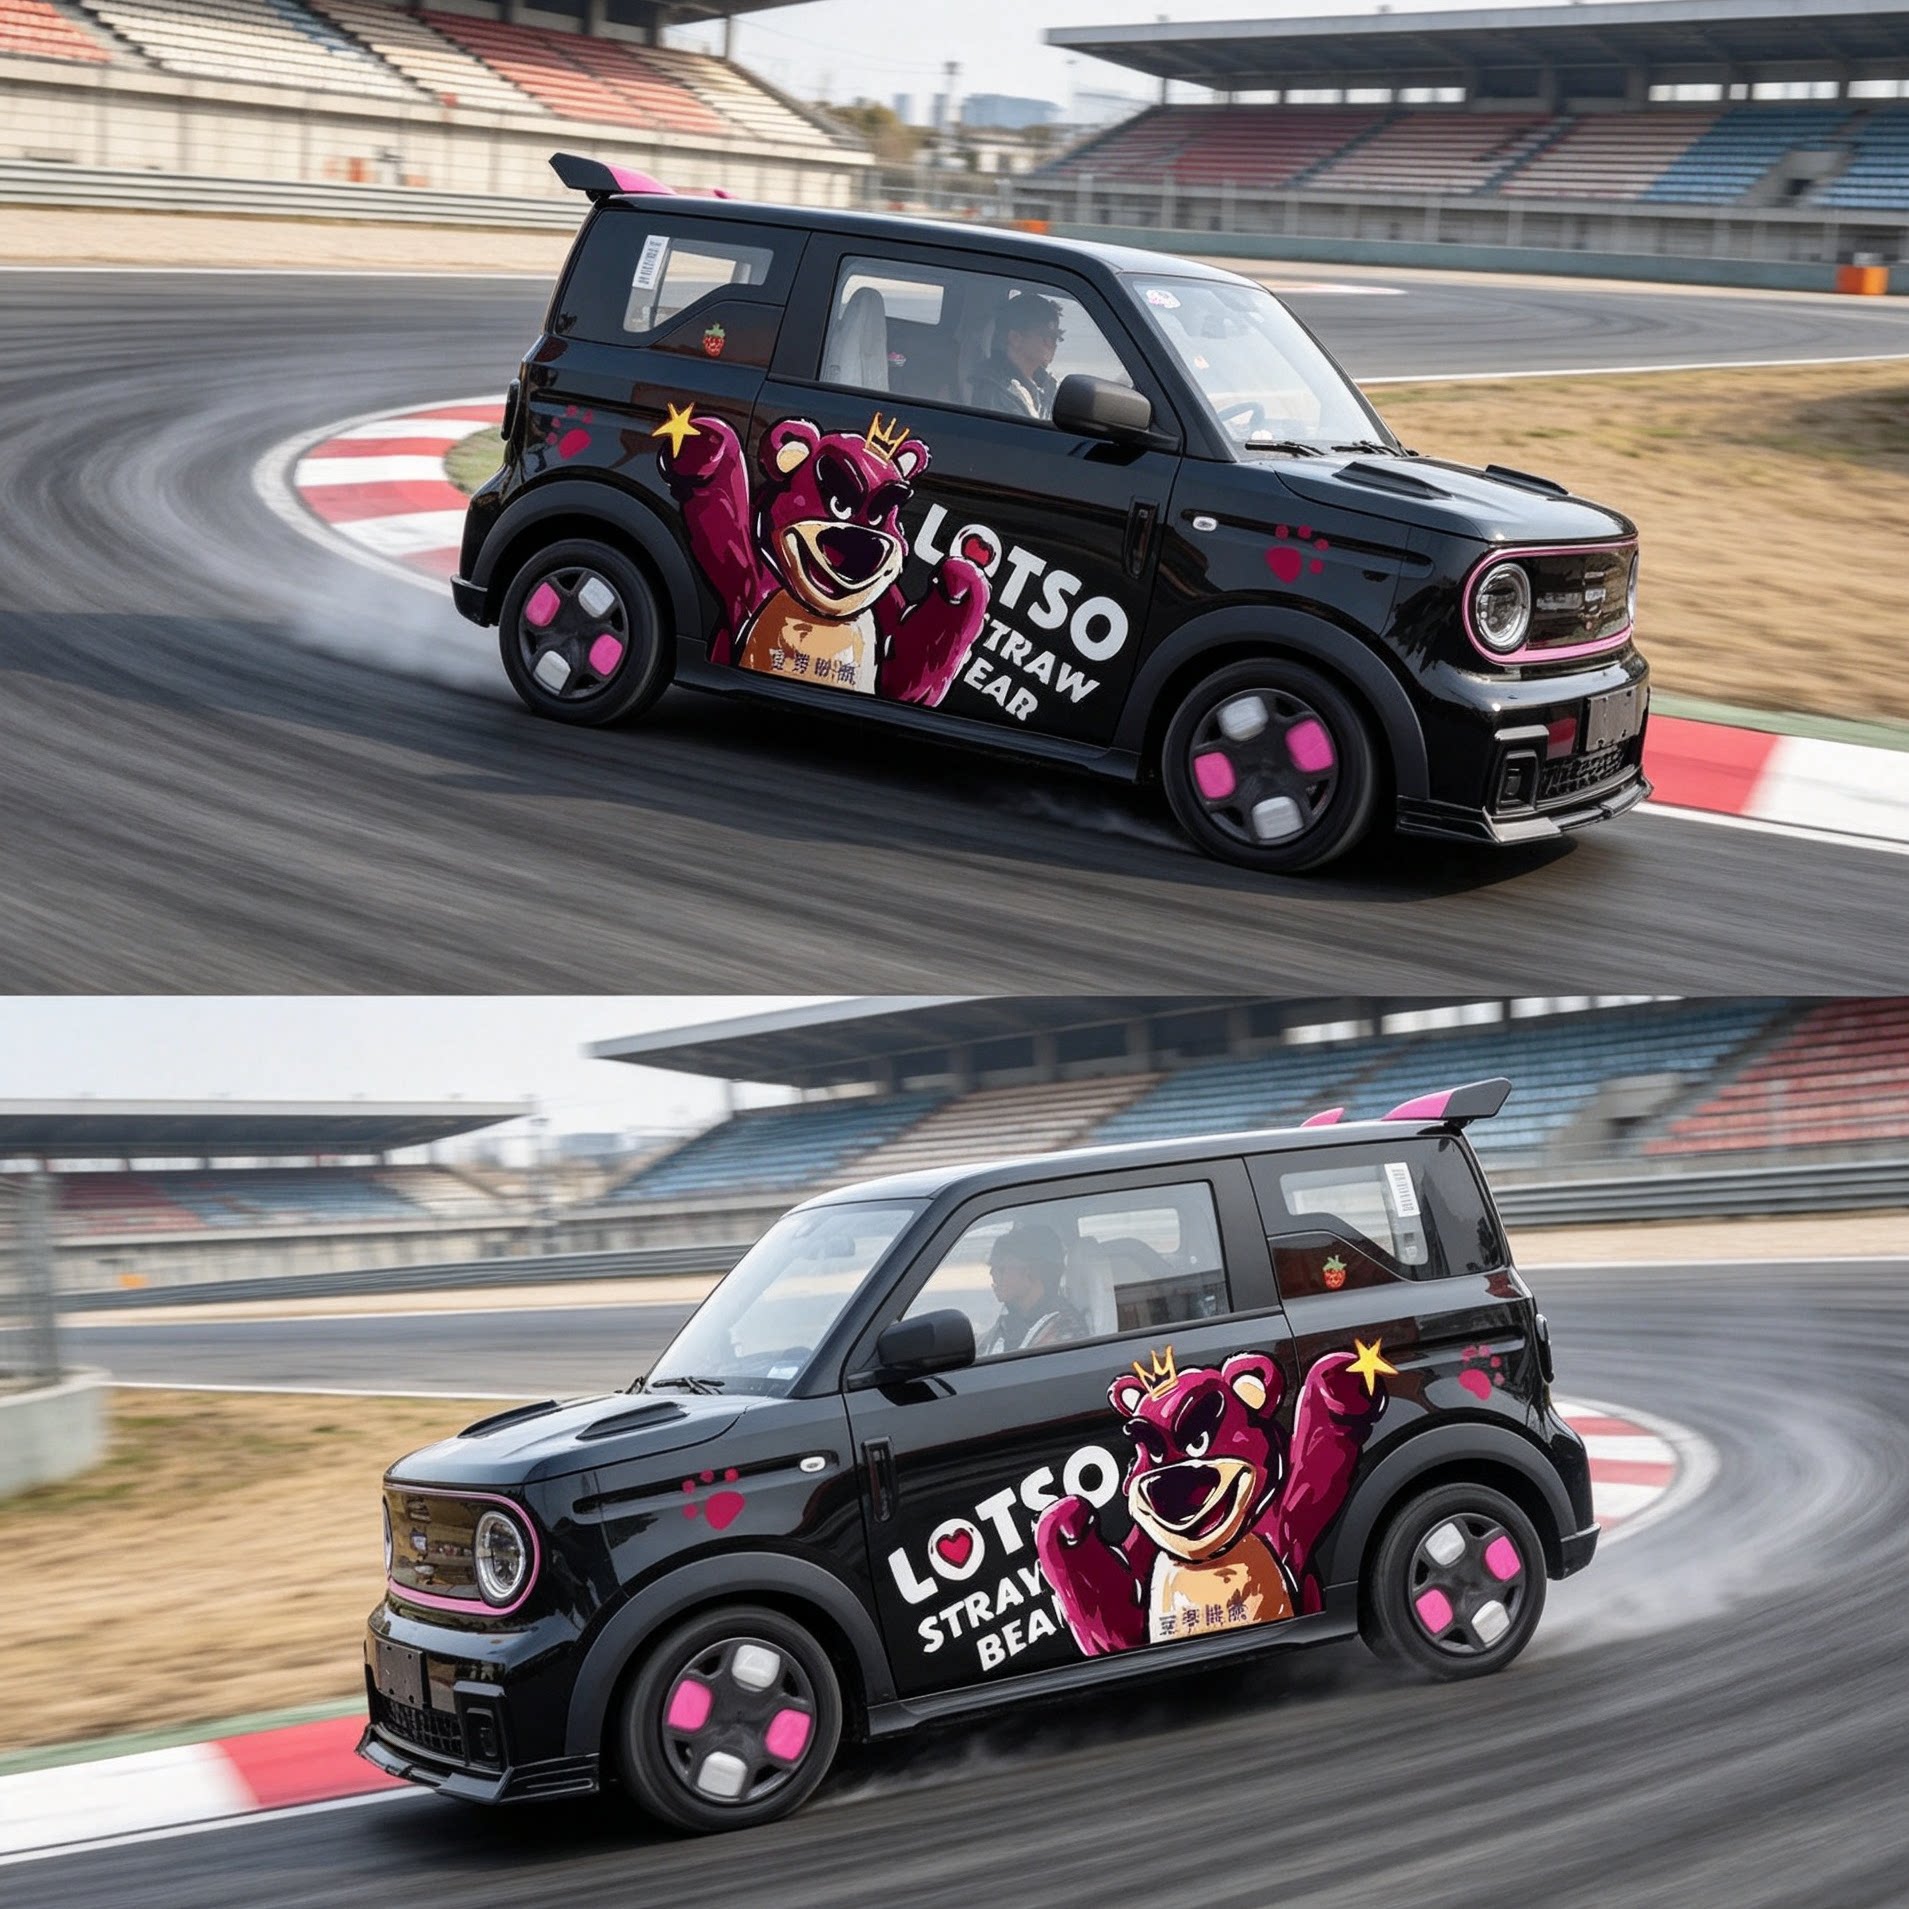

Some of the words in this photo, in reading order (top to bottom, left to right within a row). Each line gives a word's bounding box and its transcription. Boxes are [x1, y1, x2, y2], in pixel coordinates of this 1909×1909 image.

[914, 503, 1129, 662] LOTSO
[962, 650, 1039, 722] EAR
[982, 612, 1101, 704] TRAW
[887, 1445, 1120, 1605] LOTSO
[975, 1594, 1065, 1673] BEA
